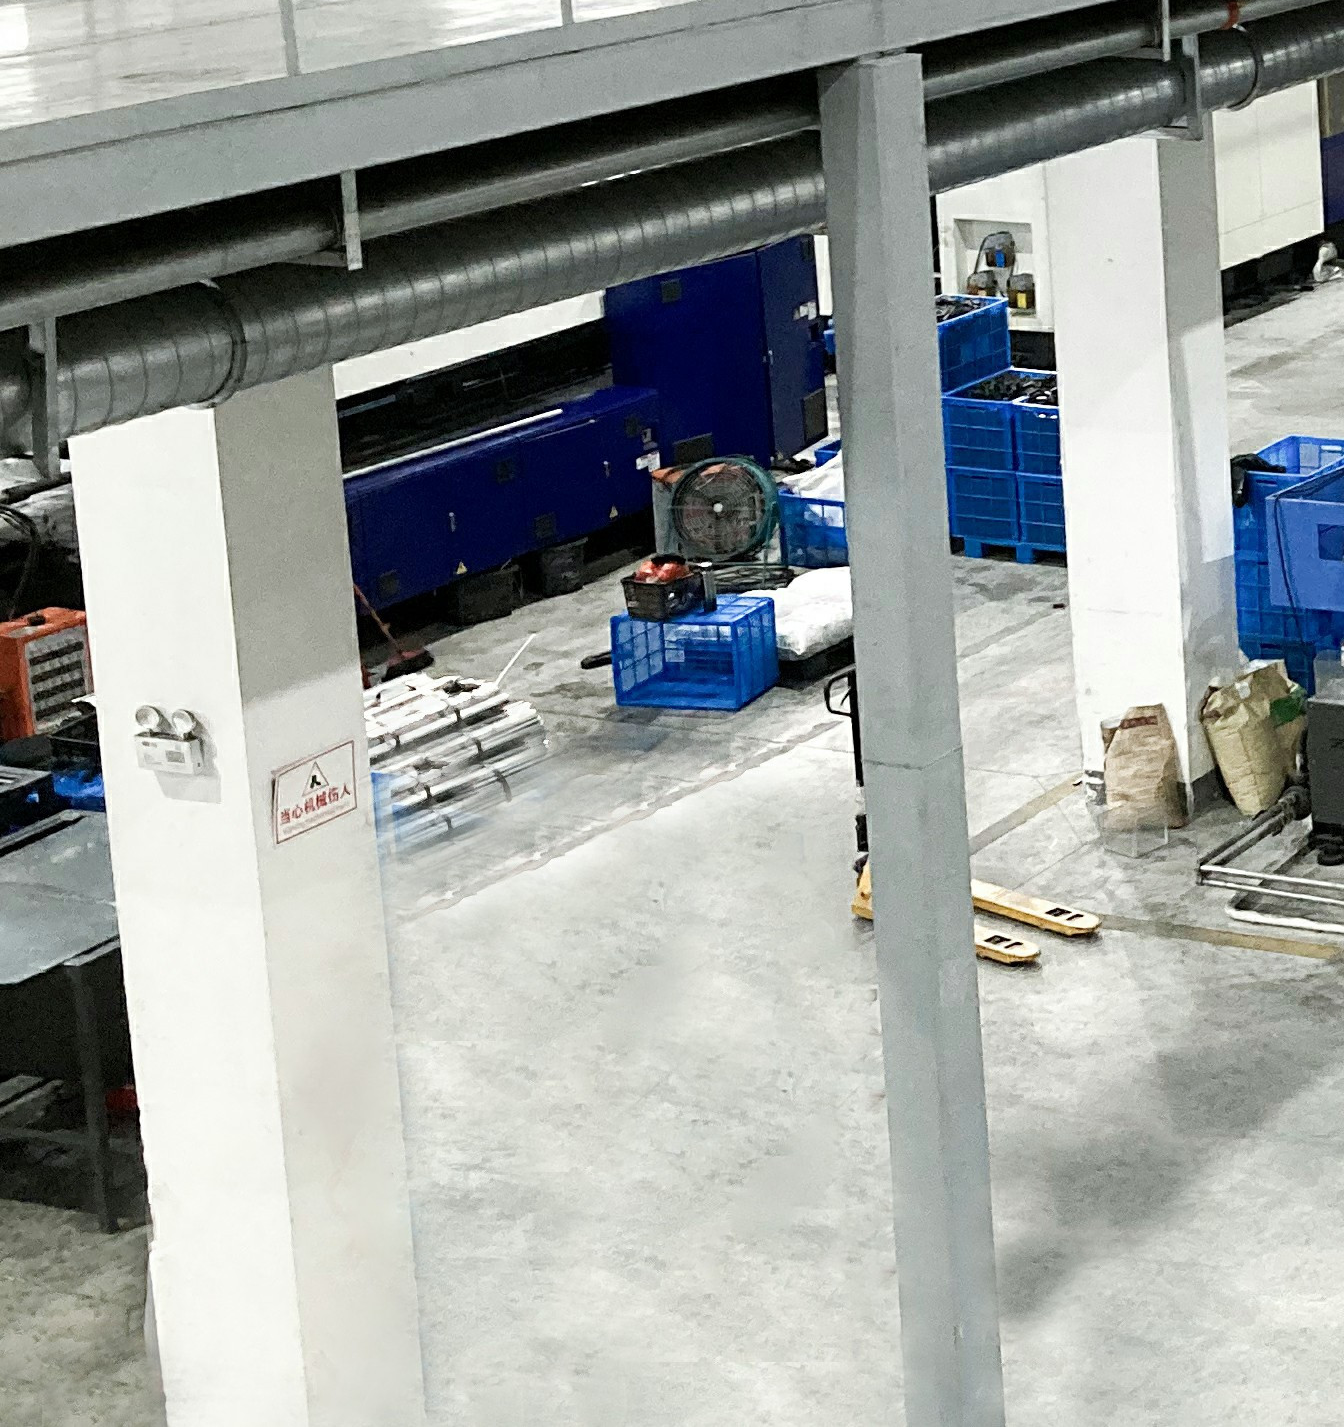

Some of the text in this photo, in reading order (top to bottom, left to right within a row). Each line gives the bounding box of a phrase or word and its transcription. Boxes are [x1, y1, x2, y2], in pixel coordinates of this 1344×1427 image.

[281, 784, 351, 824] 当心机械伤人
